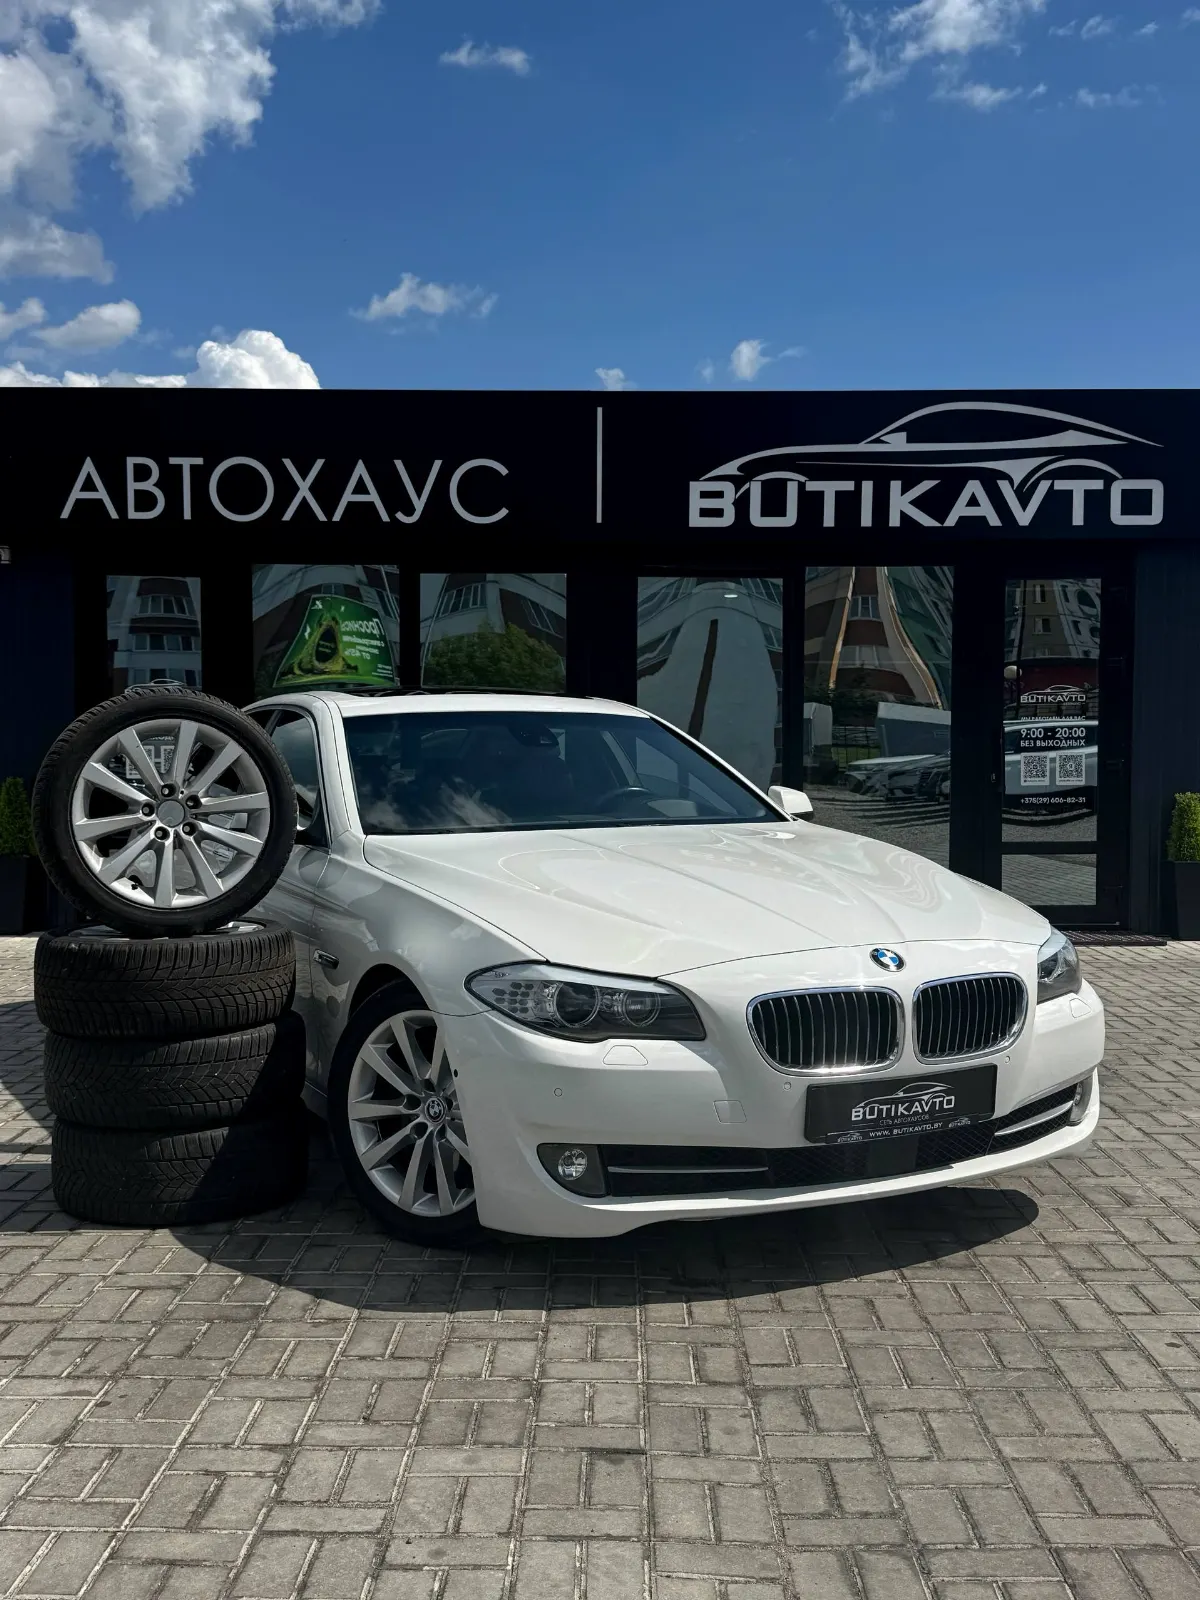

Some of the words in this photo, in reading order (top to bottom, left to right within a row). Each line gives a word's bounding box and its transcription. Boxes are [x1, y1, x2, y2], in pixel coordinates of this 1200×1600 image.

[60, 456, 510, 525] АВТОХАУС
[688, 479, 1165, 528] BUTIKAVTO
[1021, 695, 1086, 703] BUTIKAVTO
[1020, 728, 1045, 738] 9:00
[1055, 727, 1086, 738] 20:00
[1020, 739, 1034, 747] БЕЗ
[1036, 739, 1085, 748] ВЫХОДНЫХ
[1021, 797, 1050, 805] +375(29)
[1050, 796, 1086, 804] 606-82-31
[851, 1095, 955, 1121] BUTIKAVTO
